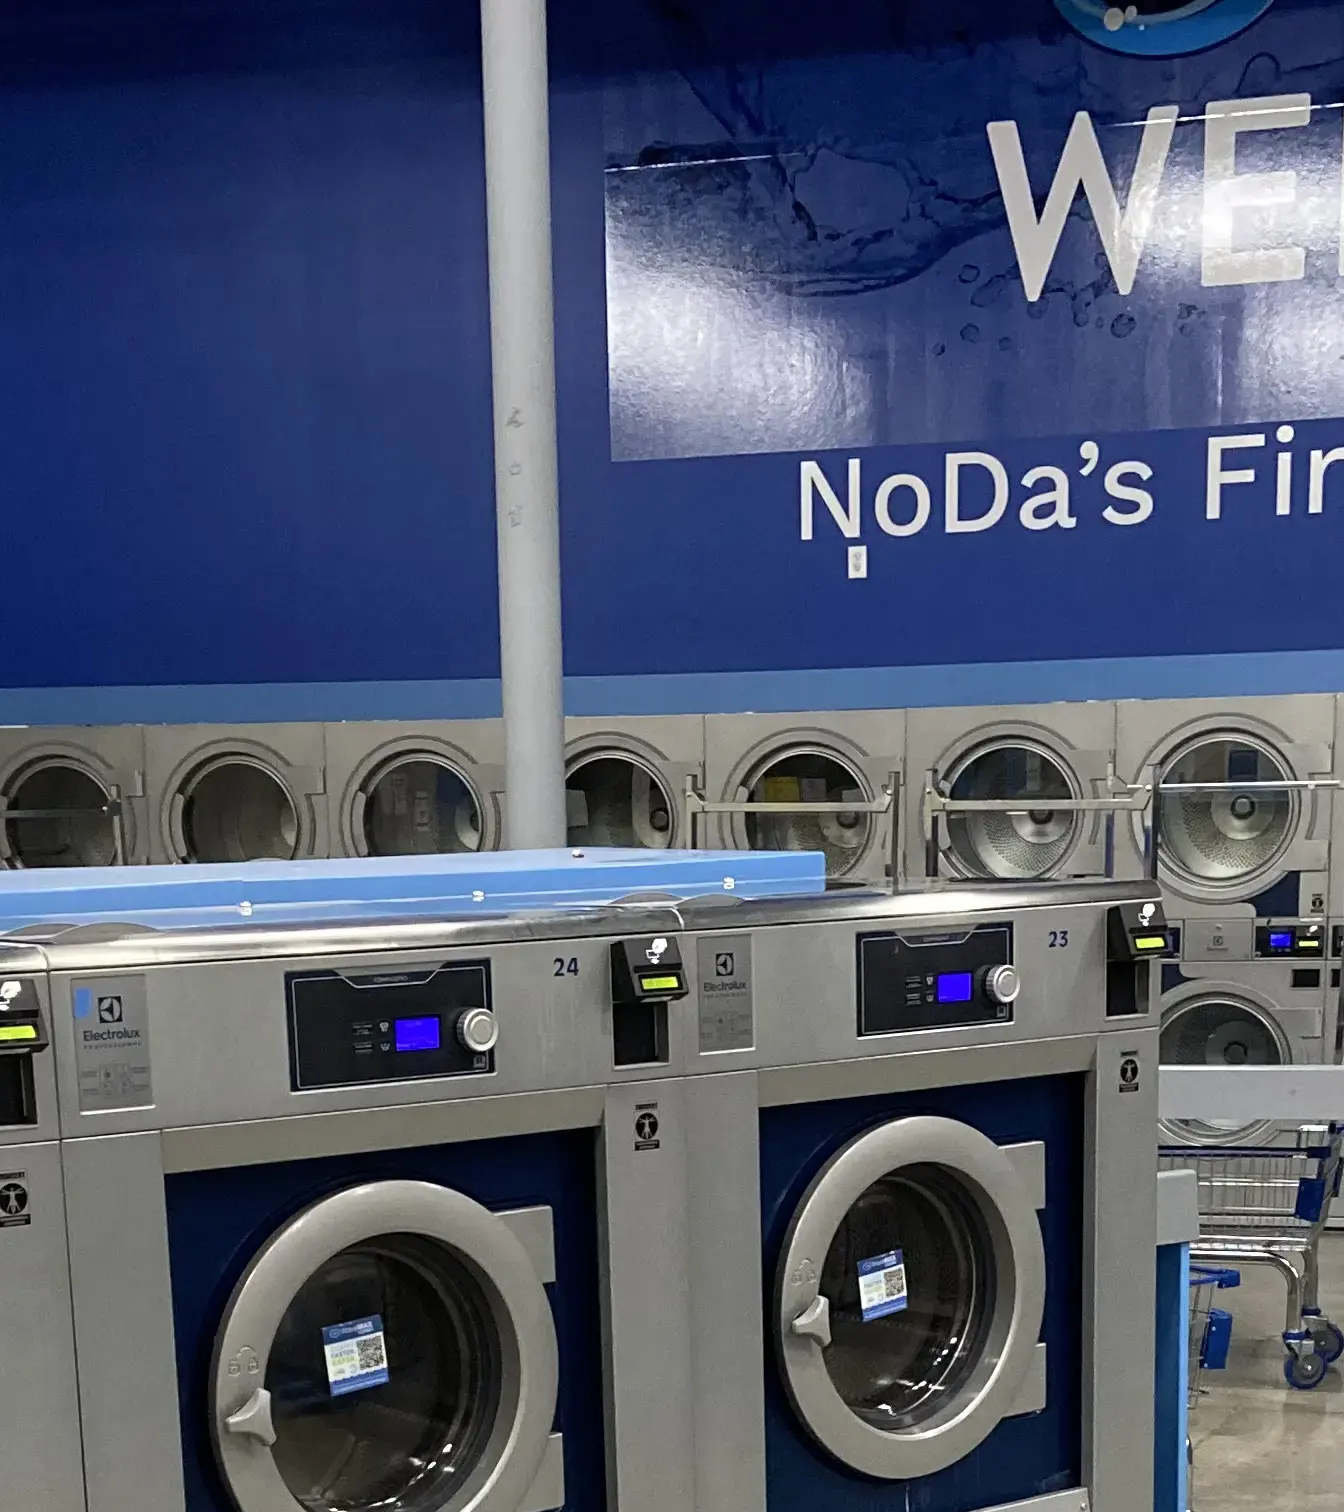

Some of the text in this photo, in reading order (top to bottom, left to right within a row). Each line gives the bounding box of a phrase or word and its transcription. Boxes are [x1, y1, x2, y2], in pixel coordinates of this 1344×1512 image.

[1048, 930, 1068, 948] 23
[552, 956, 579, 977] 24
[82, 1028, 141, 1042] Electrolux
